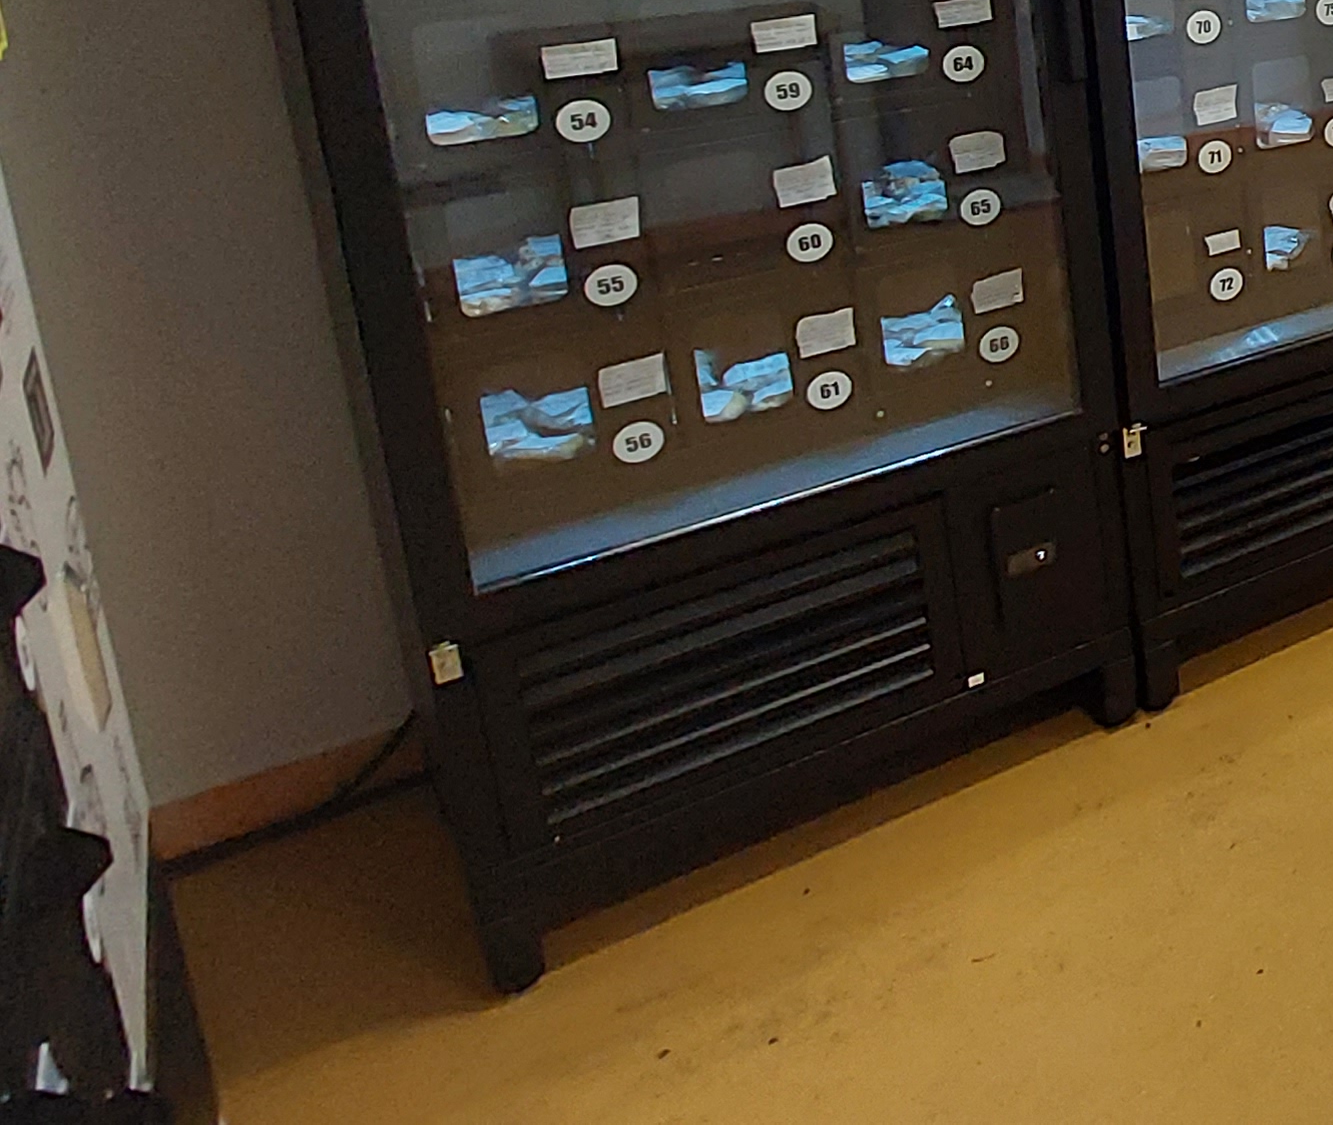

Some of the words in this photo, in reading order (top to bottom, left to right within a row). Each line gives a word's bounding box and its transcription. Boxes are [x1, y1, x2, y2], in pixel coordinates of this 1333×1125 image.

[1195, 19, 1212, 35] 70
[953, 55, 974, 72] 64
[775, 82, 801, 100] 59
[570, 112, 598, 131] 54
[1208, 149, 1222, 164] 71
[970, 198, 991, 216] 65
[798, 233, 822, 252] 60
[597, 275, 624, 295] 55
[1219, 277, 1234, 292] 72
[820, 381, 840, 399] 61
[625, 432, 652, 453] 56
